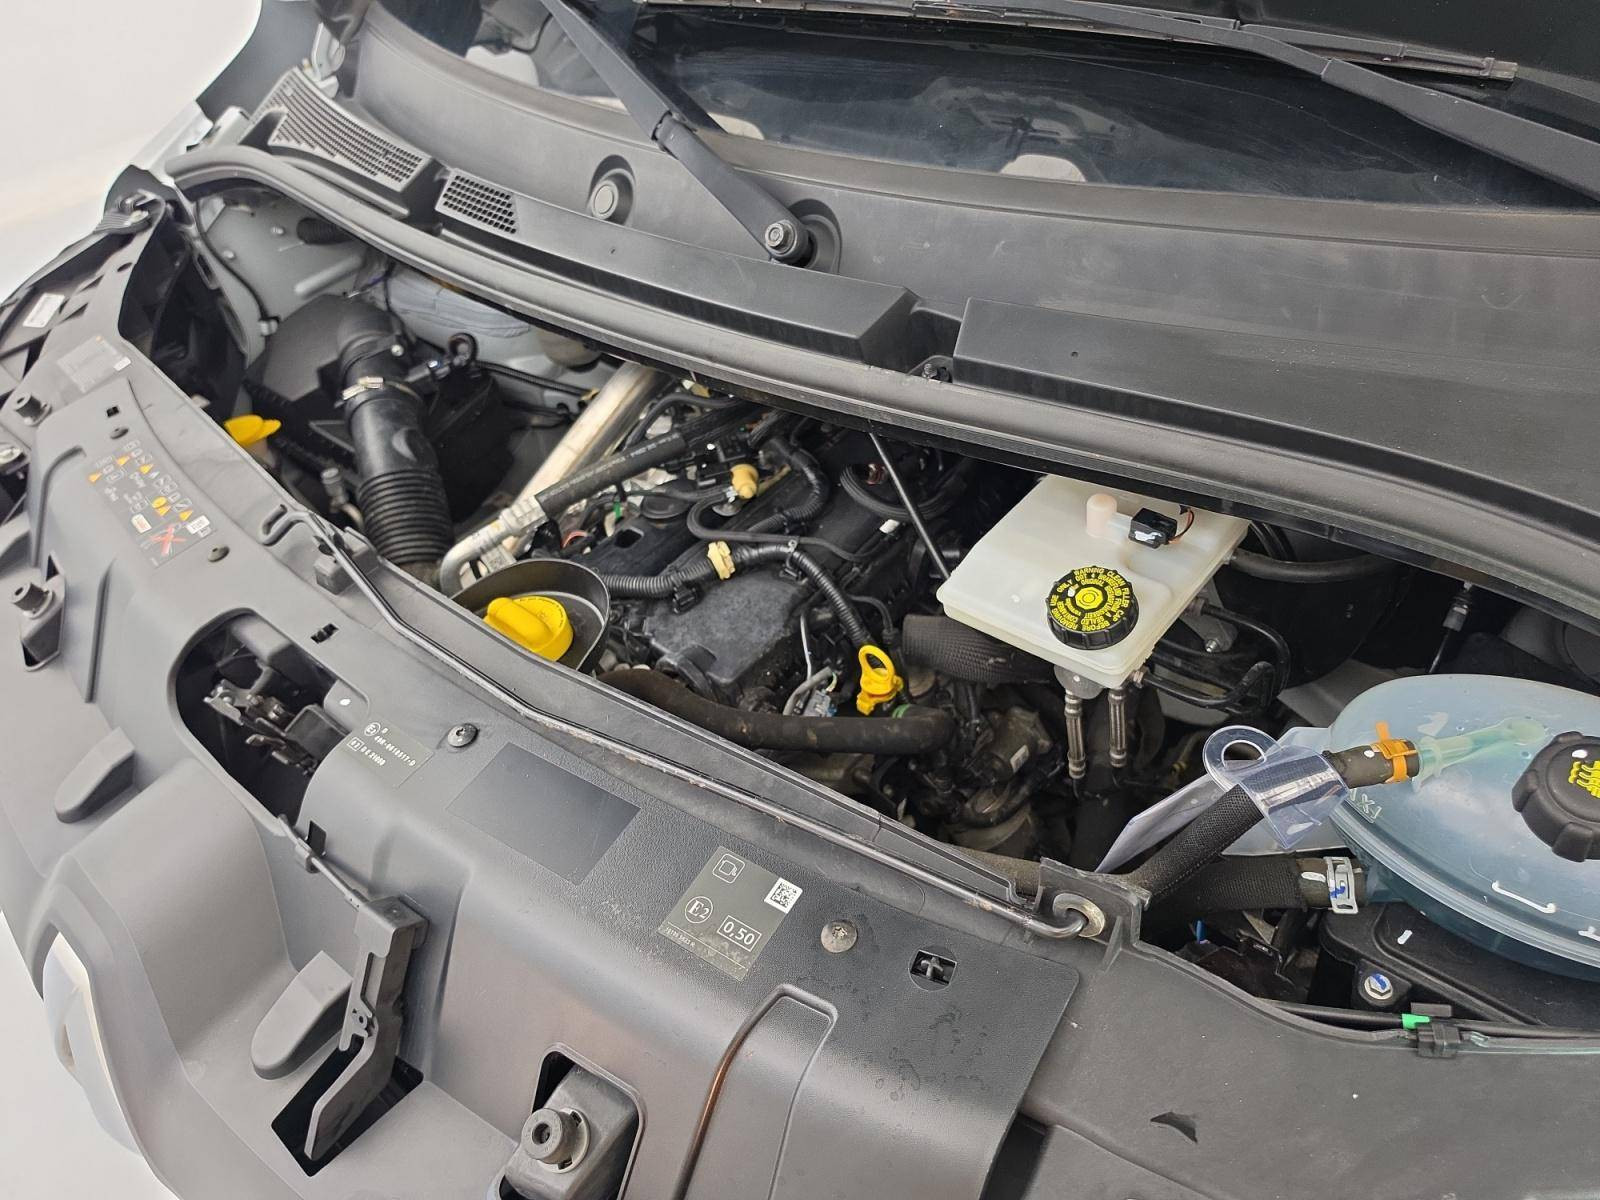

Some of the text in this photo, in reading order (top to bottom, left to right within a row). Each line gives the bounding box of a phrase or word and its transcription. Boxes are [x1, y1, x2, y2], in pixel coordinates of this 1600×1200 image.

[1075, 573, 1087, 582] DOT
[1050, 567, 1131, 631] WARNING CLEAN FILLER CAP BEFORE REMOVING USE ONLY
[1110, 598, 1122, 613] FROM
[1081, 615, 1105, 625] SEALED
[688, 900, 709, 919] E2
[723, 922, 754, 945] 0,50
